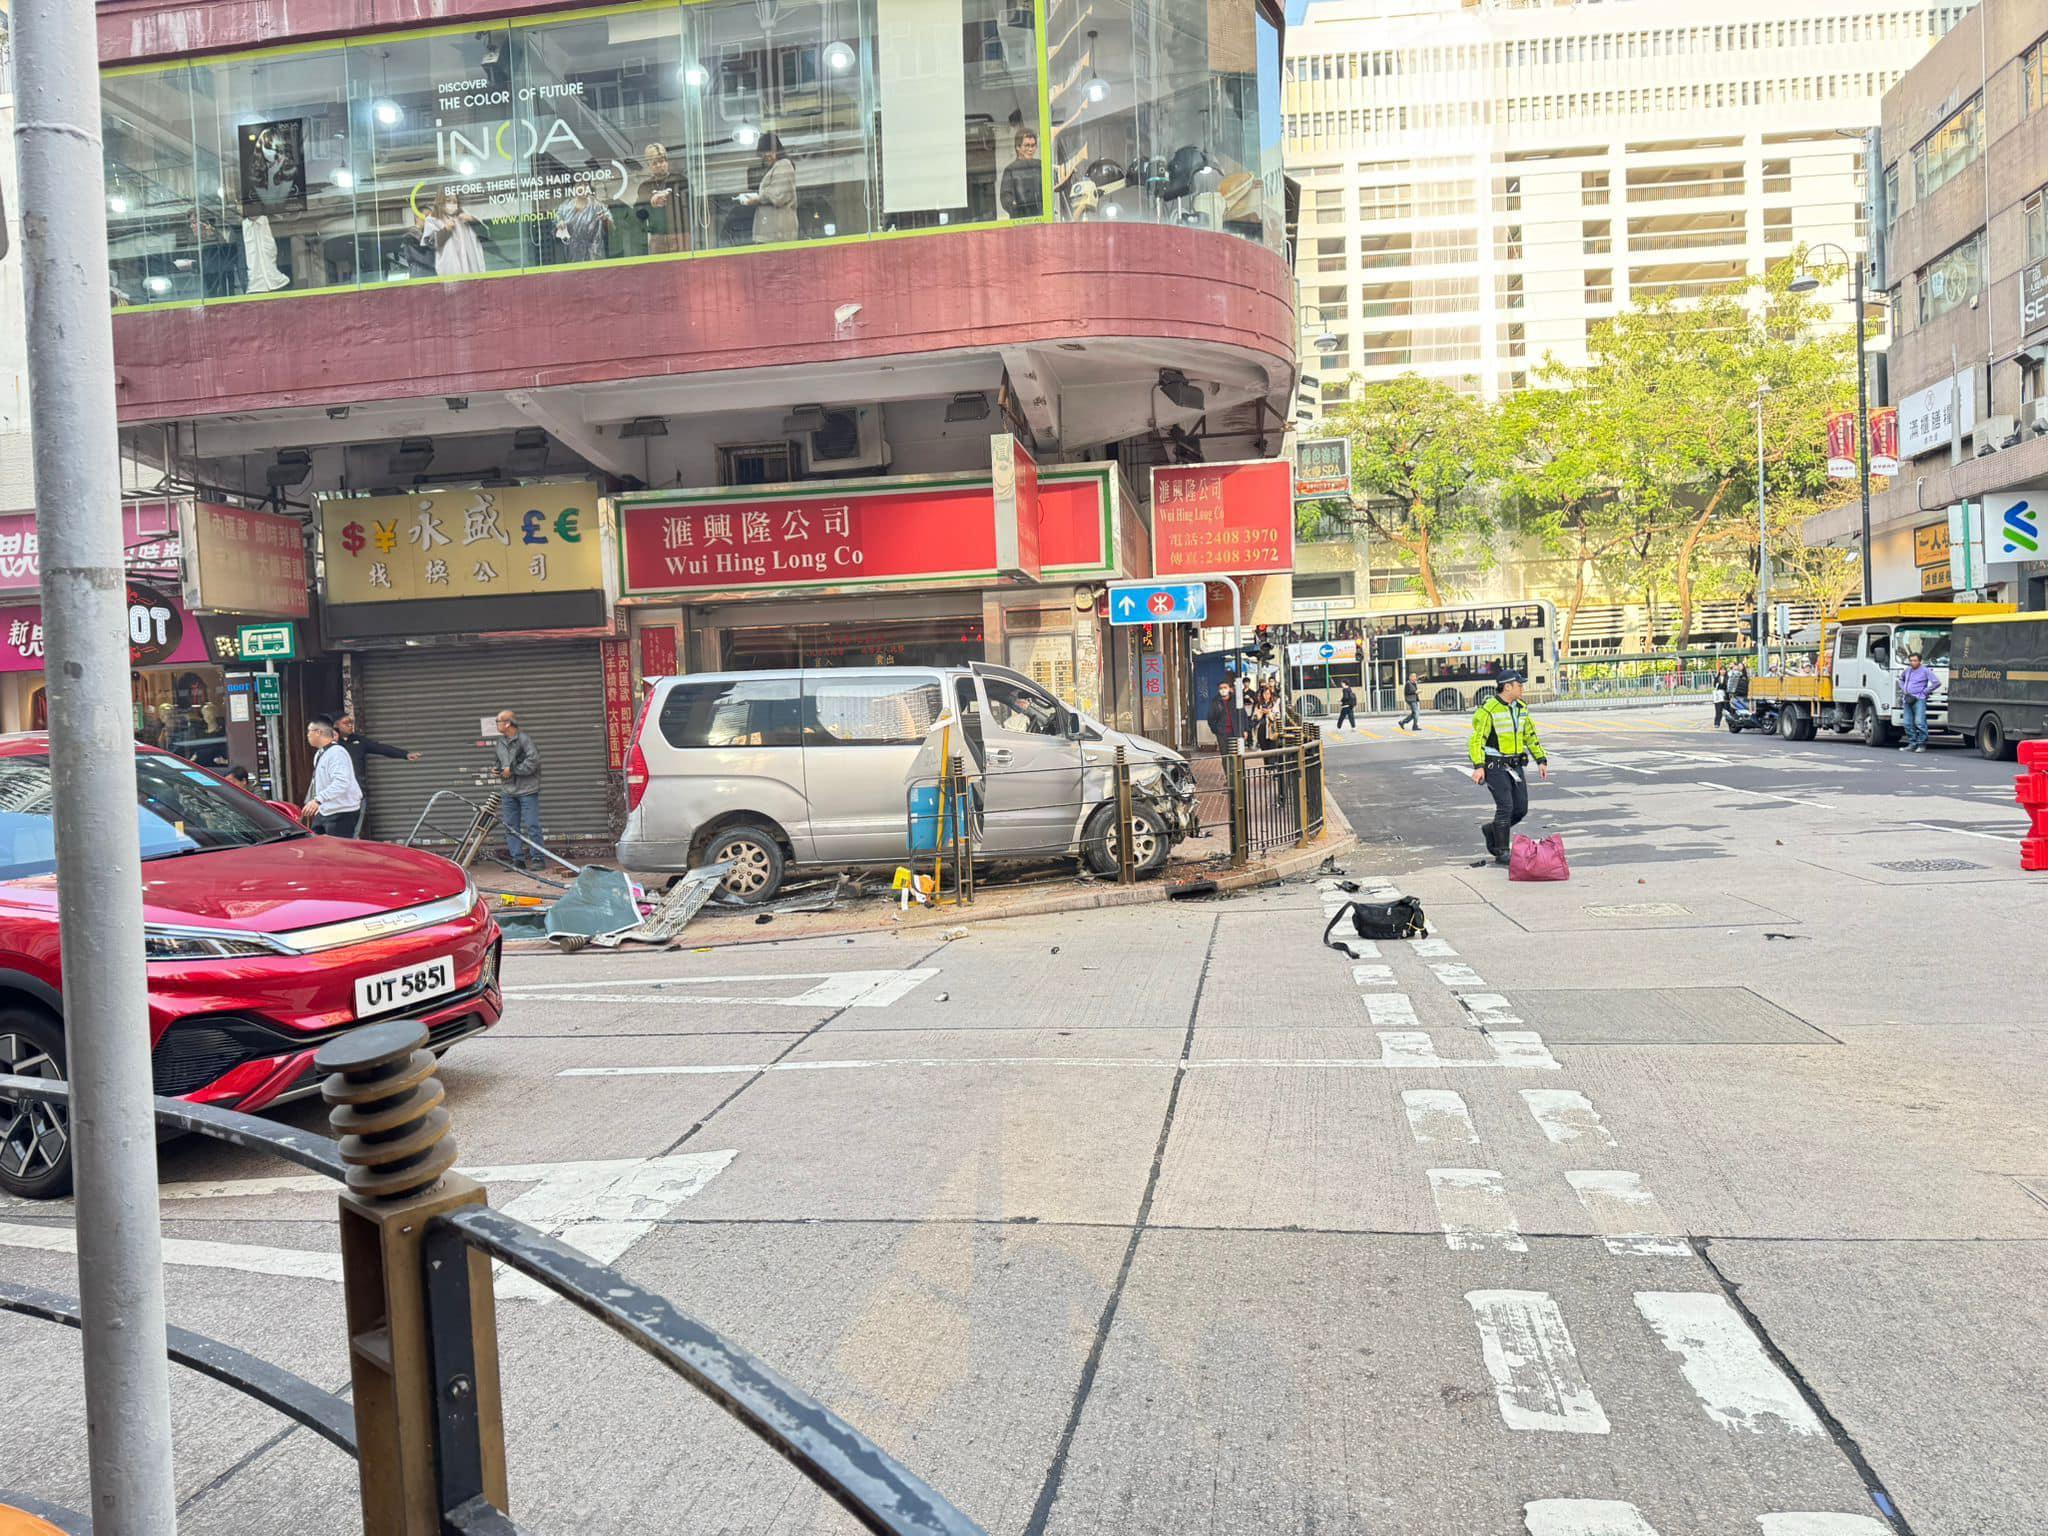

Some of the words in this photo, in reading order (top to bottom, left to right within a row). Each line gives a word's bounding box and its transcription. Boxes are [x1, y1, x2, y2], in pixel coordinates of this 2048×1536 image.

[438, 79, 488, 93] DISCOVER
[439, 97, 463, 111] THE
[464, 92, 509, 107] COLOR
[519, 88, 537, 101] OF
[540, 82, 584, 98] FUTURE
[486, 178, 515, 191] THERE
[520, 175, 543, 188] WAS
[545, 172, 571, 185] HAIR
[520, 190, 550, 202] THERE
[552, 189, 562, 199] IS
[2024, 294, 2048, 322] SE
[408, 494, 510, 551] 永盛
[1244, 528, 1278, 544] 3970
[664, 554, 709, 576] Wui
[715, 553, 766, 576] Hing
[772, 550, 827, 572] Long
[834, 546, 864, 566] Co
[1244, 547, 1279, 562] 3972
[129, 605, 171, 645] OT
[1145, 657, 1160, 694] 天格
[366, 977, 397, 1006] UT
[401, 964, 446, 998] 5851
